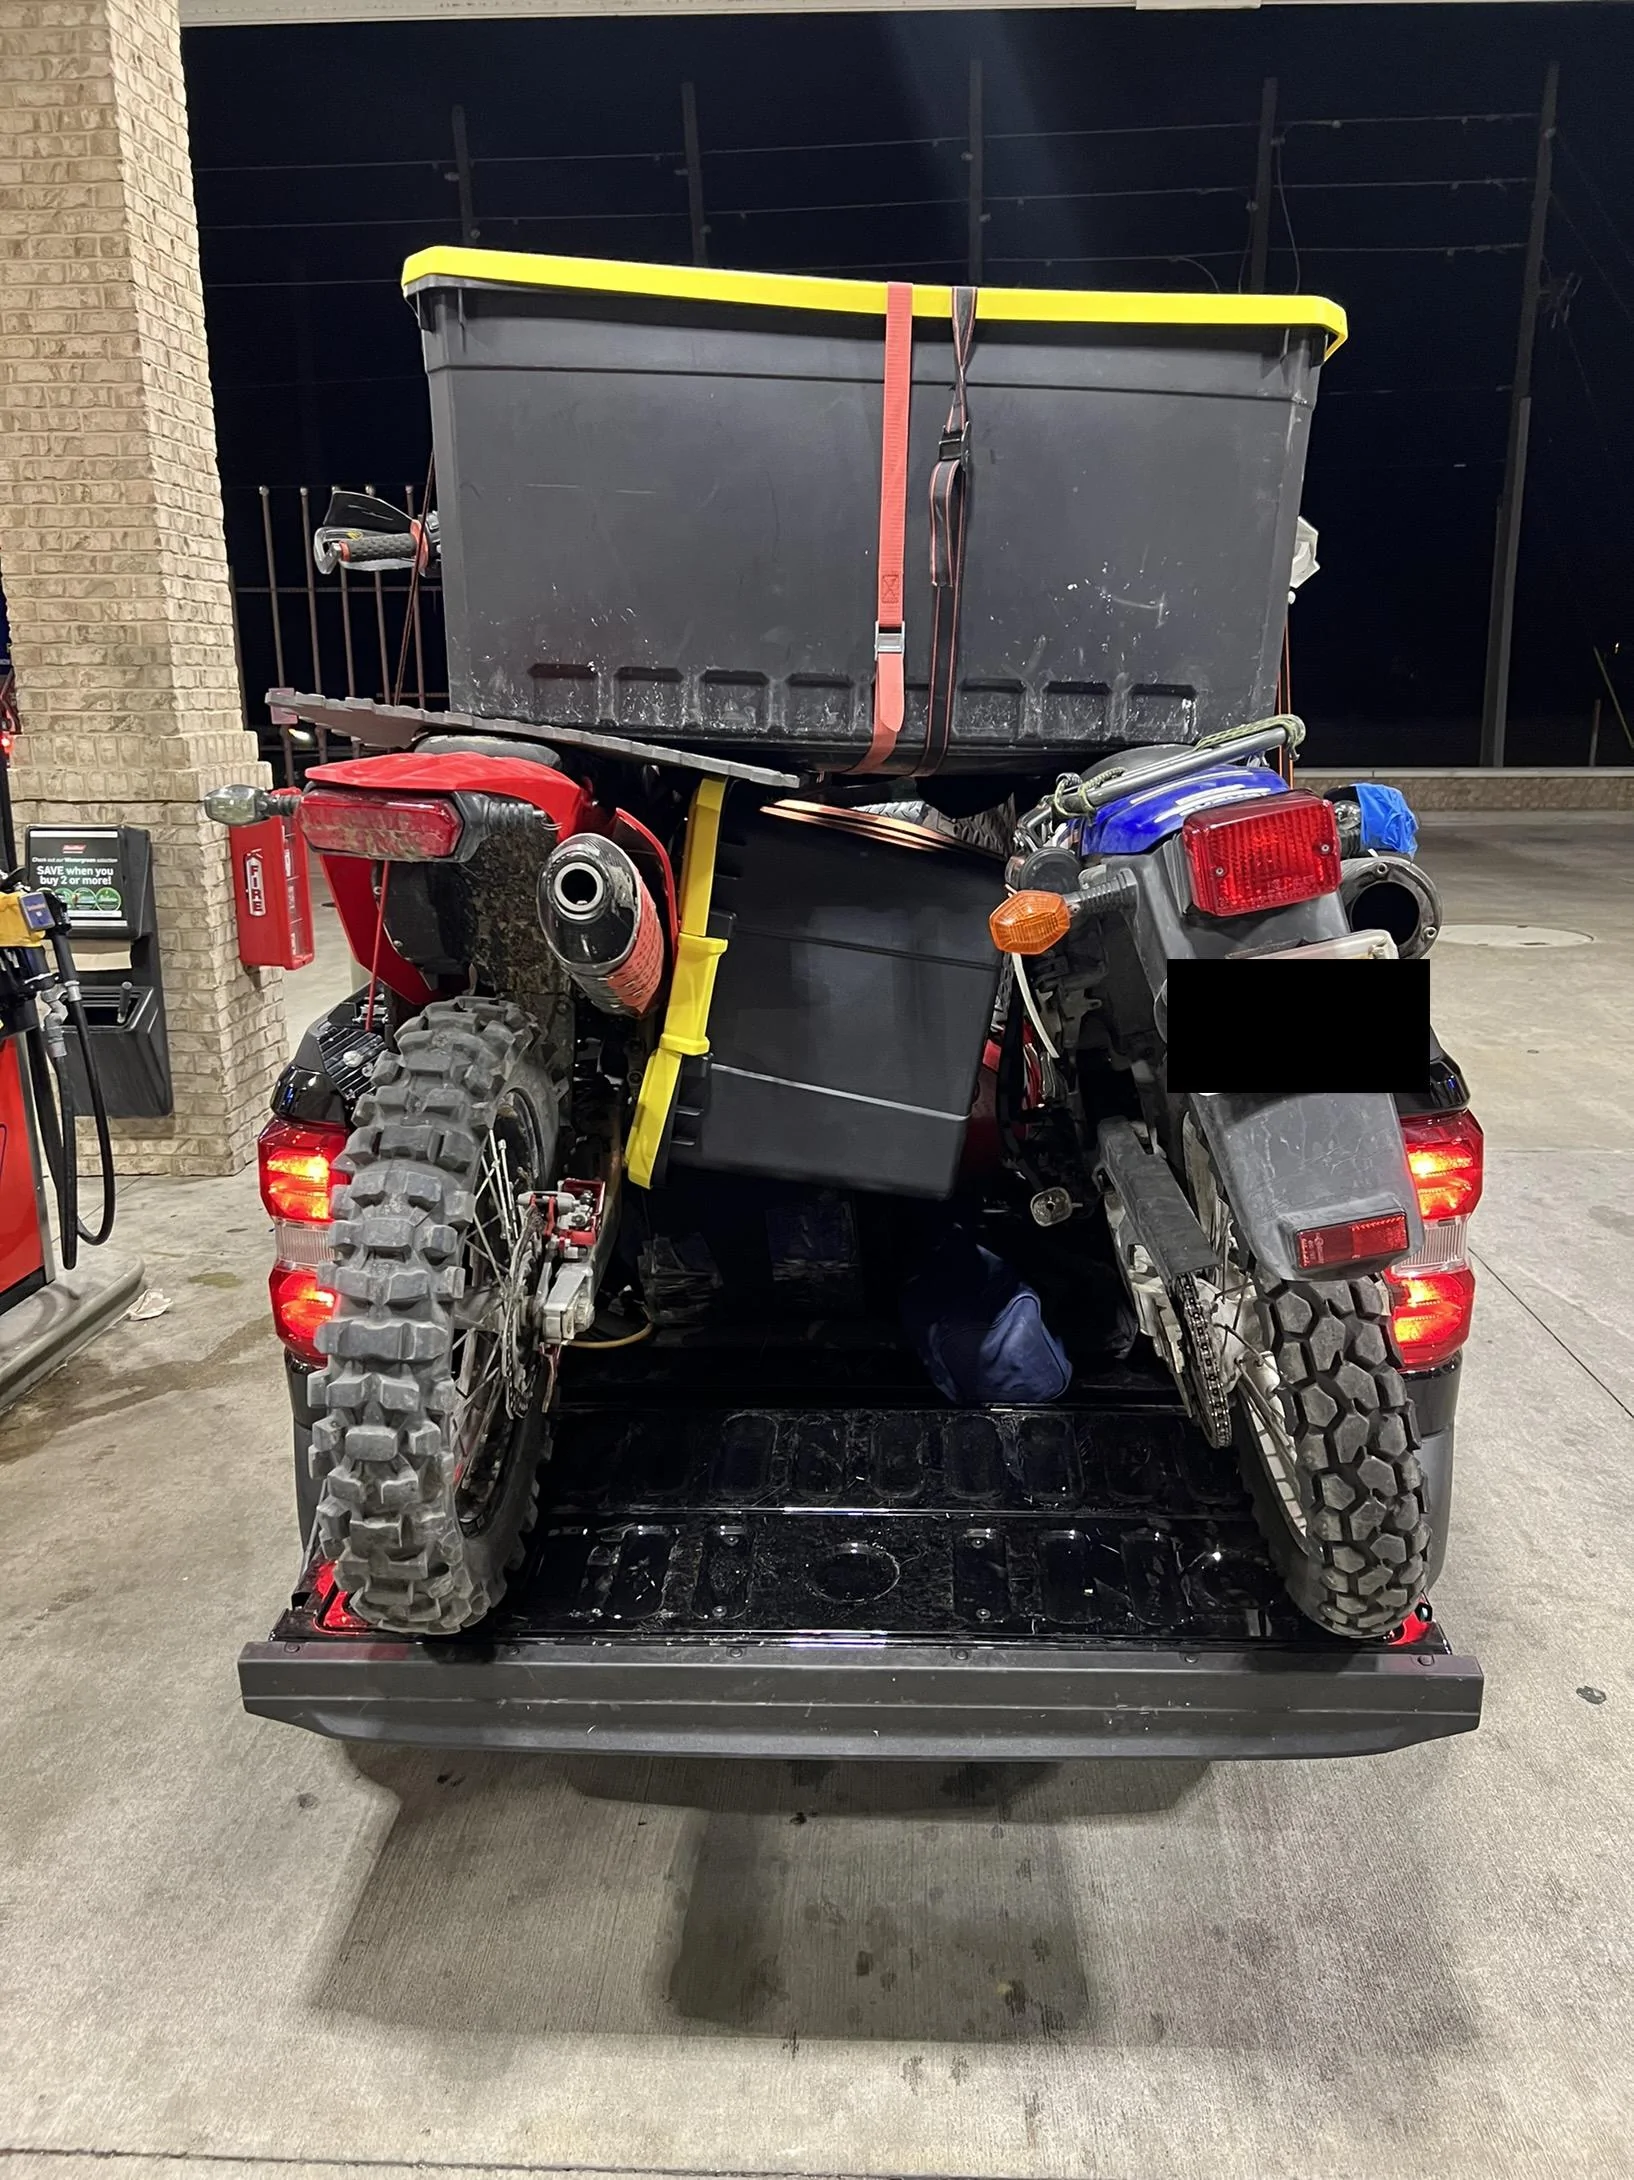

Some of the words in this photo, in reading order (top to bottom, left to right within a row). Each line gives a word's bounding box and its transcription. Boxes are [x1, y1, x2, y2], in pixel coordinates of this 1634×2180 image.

[36, 865, 64, 875] SAVE
[65, 866, 93, 876] when
[95, 868, 114, 878] you
[40, 876, 59, 886] buy
[60, 876, 67, 885] 2
[69, 877, 80, 885] or
[82, 876, 112, 885] more!
[250, 865, 263, 912] FIRE
